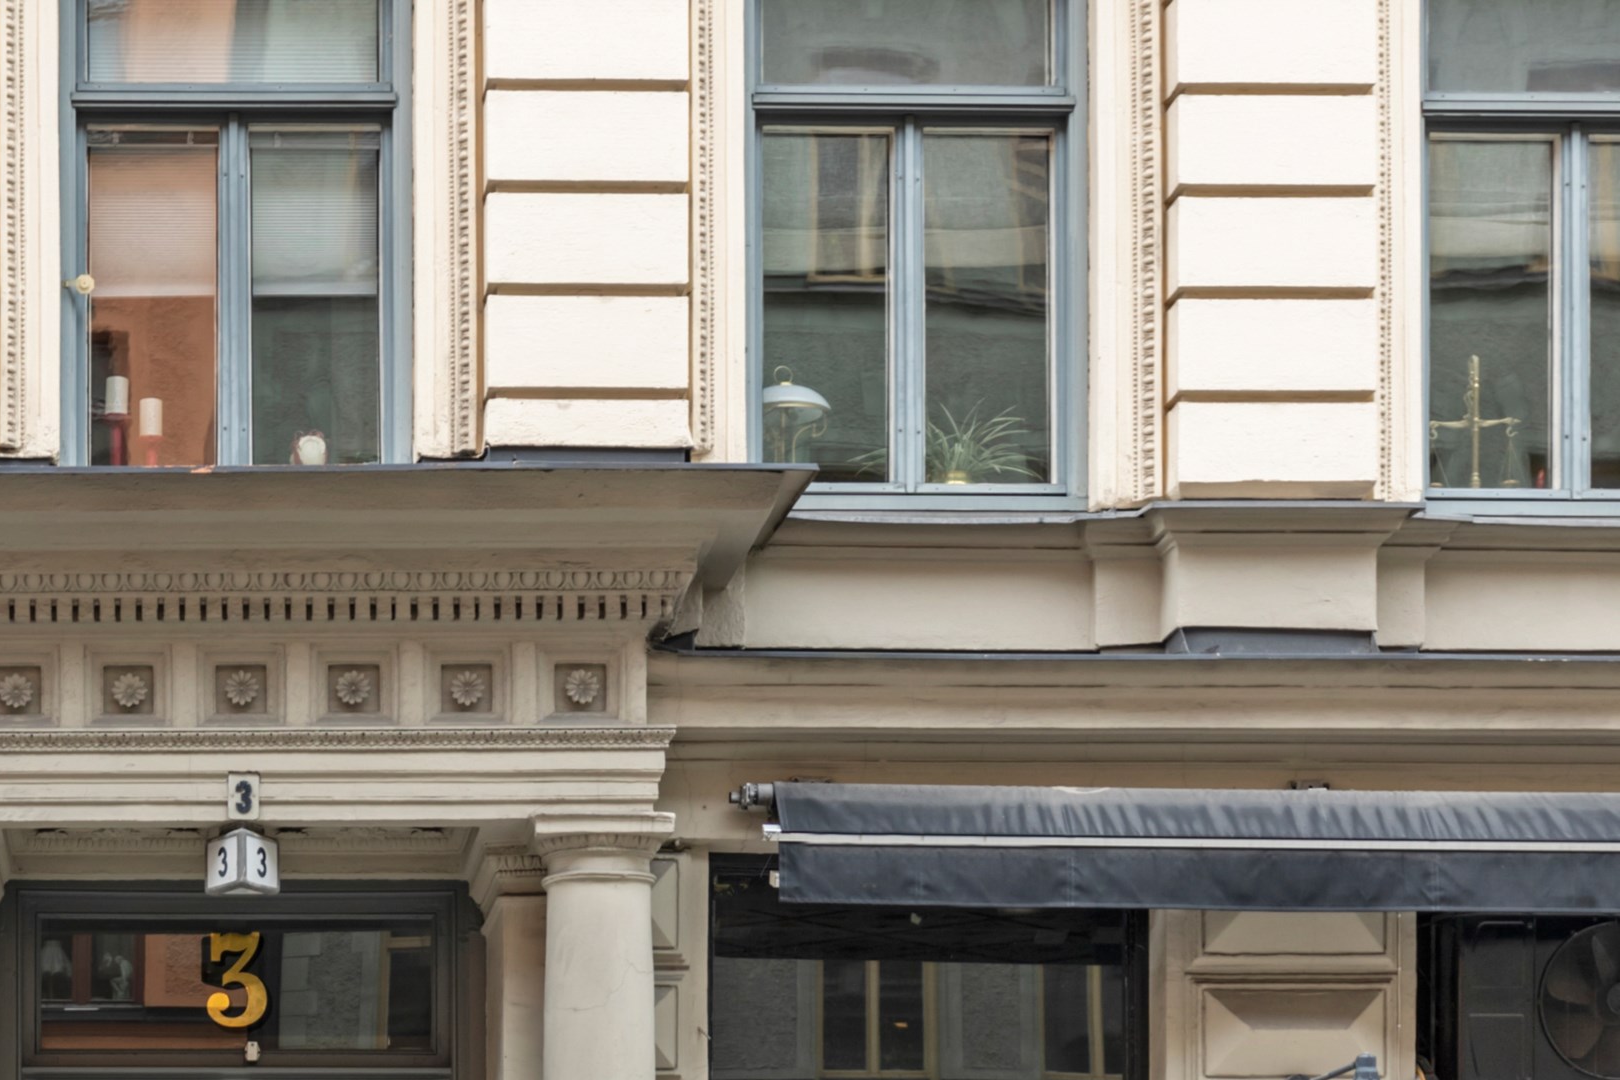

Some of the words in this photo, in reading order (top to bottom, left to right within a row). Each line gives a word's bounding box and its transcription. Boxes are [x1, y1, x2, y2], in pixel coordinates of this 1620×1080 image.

[235, 780, 253, 814] 3
[217, 847, 229, 878] 3
[256, 847, 268, 878] 3
[206, 931, 268, 1028] 3
